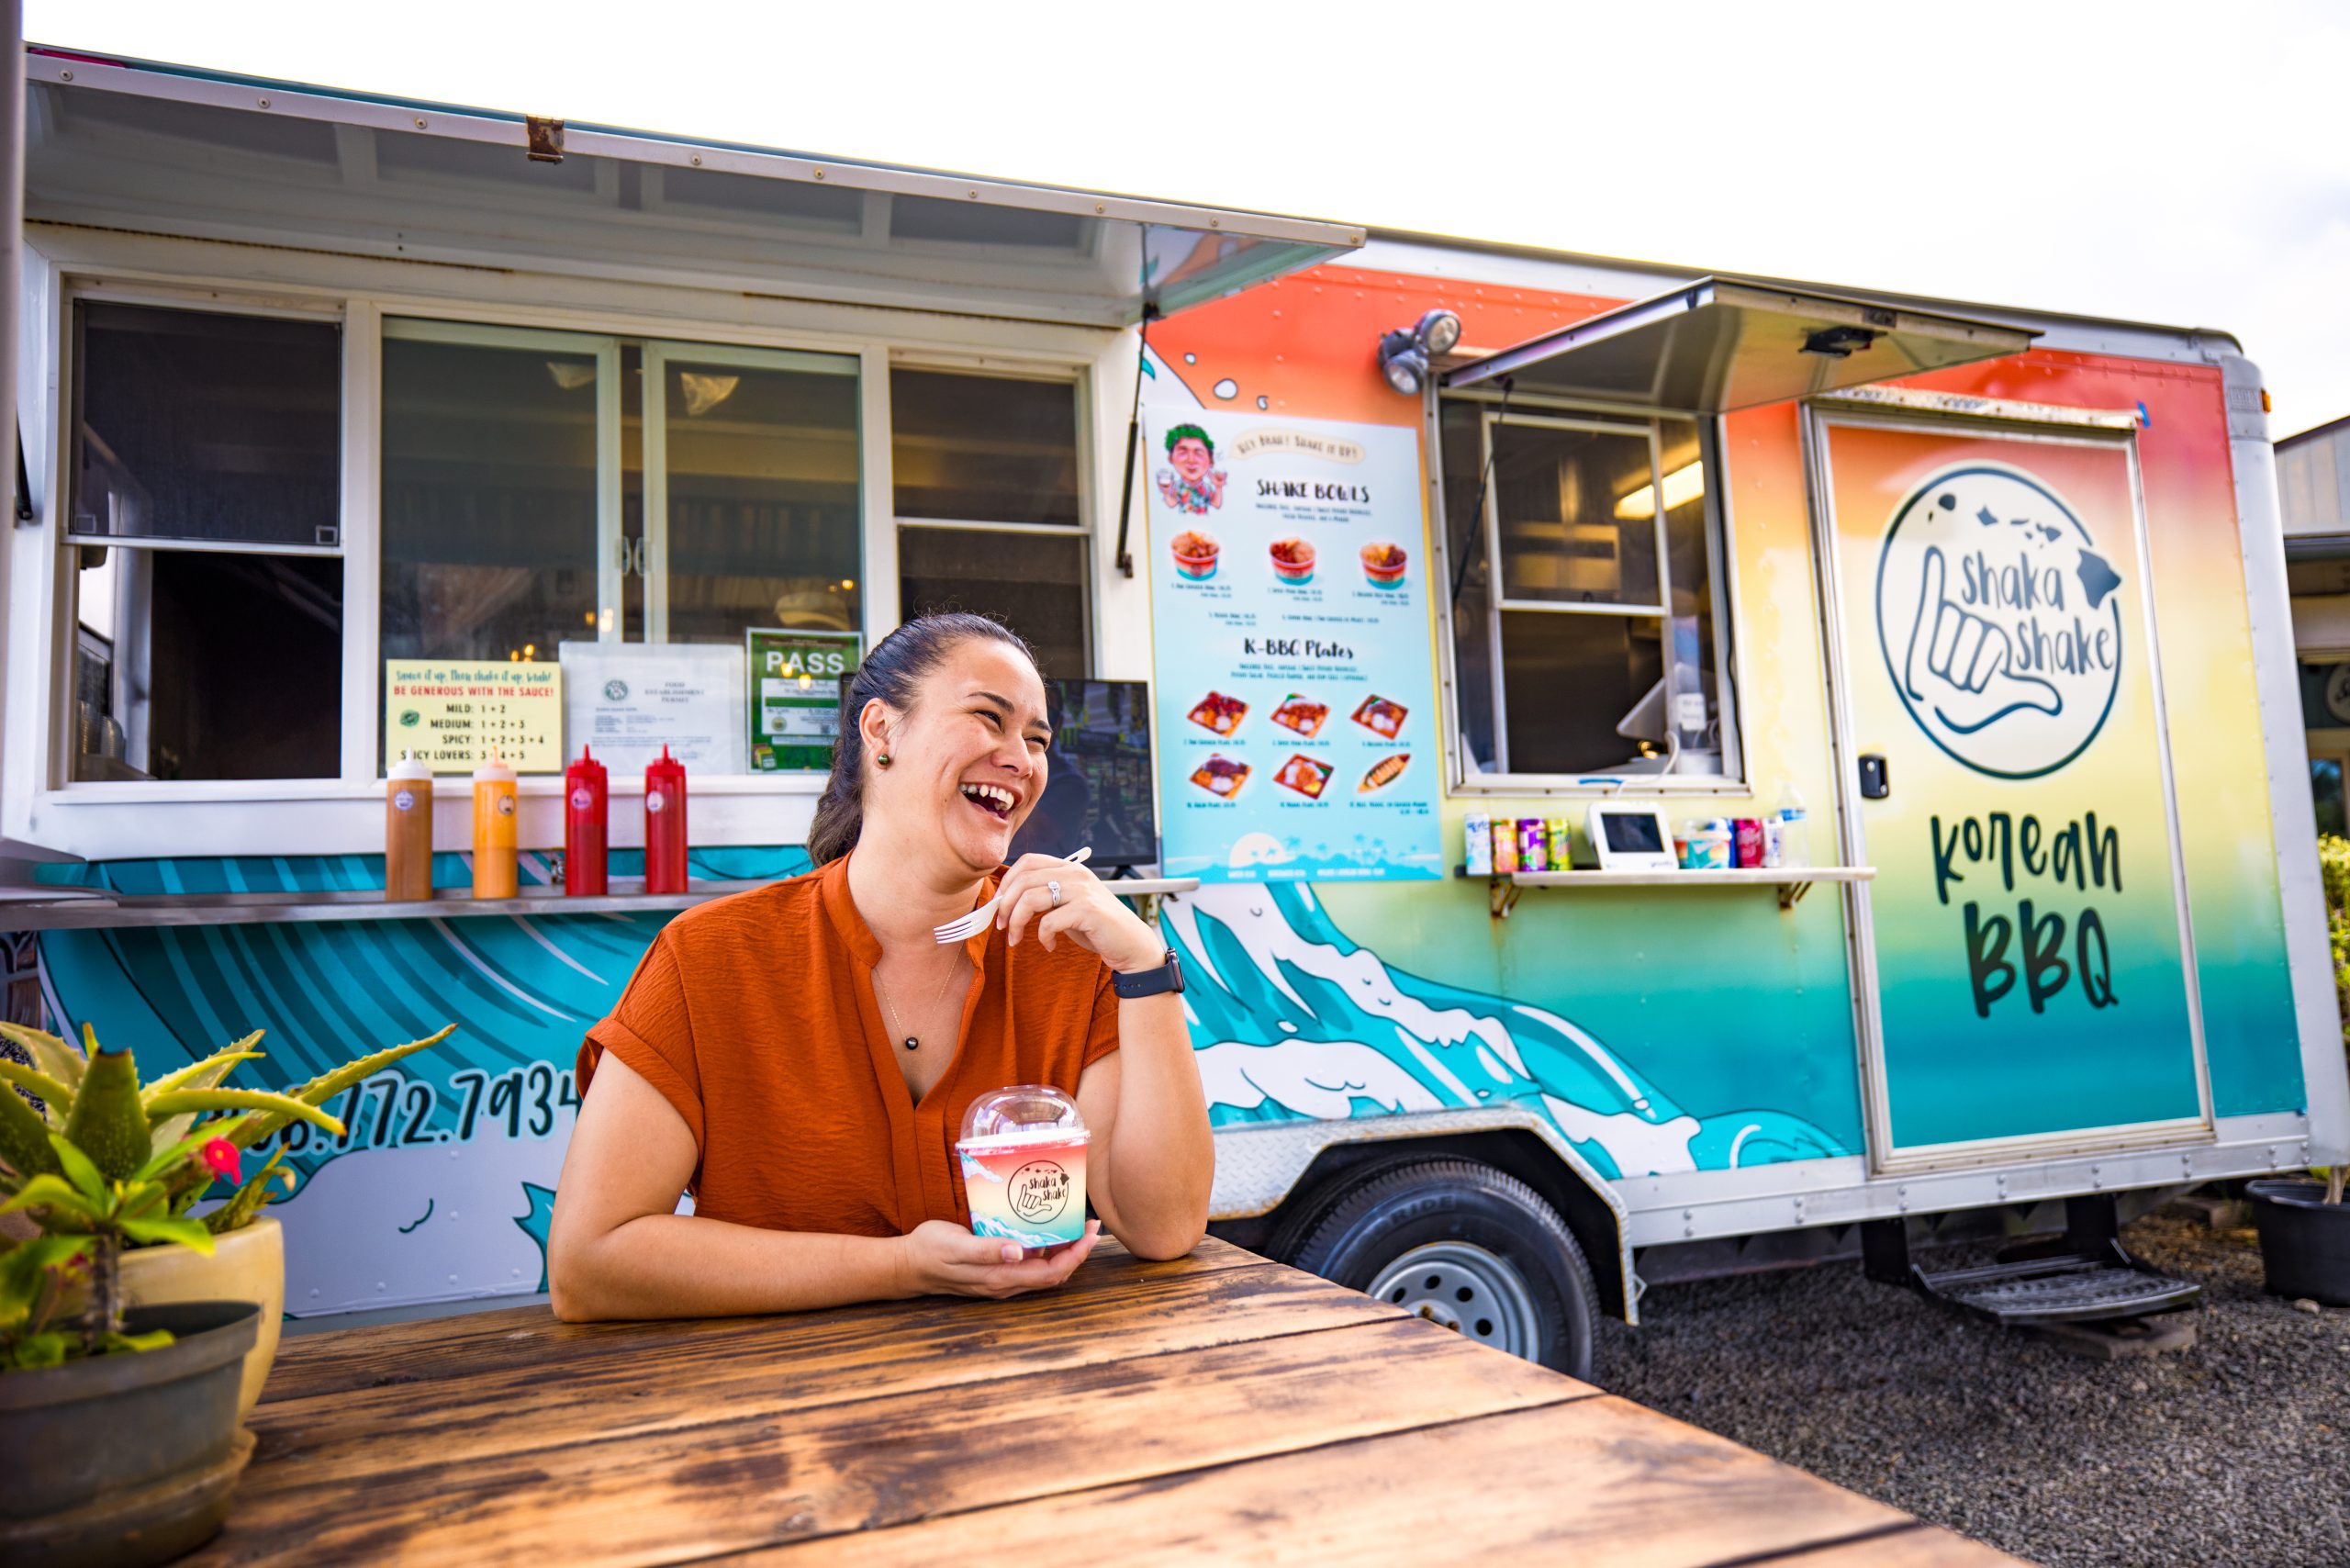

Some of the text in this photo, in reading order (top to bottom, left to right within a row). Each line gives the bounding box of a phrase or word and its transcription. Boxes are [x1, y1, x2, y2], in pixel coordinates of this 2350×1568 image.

[1257, 478, 1370, 503] SHAKE BOWLS
[1962, 550, 2065, 611] shaka
[1305, 639, 1354, 659] Plates
[2017, 615, 2113, 675] shake
[766, 650, 845, 675] PASS
[394, 685, 554, 698] BE GENEROUS WITH THE SAUCE!
[446, 703, 474, 713] MILD:
[500, 703, 506, 713] 2
[430, 720, 474, 729] MEDIUM:
[500, 720, 505, 729] 2
[519, 720, 525, 729] 3
[442, 735, 474, 745] SPICY:
[500, 735, 505, 745] 2
[519, 735, 525, 745] 3
[538, 735, 544, 745] 4
[400, 751, 429, 760] SICY
[434, 751, 474, 760] LOVERS:
[480, 751, 487, 760] 3
[519, 751, 525, 760] 5
[1963, 898, 2119, 1019] BBQ
[1029, 1176, 1057, 1189] shaka
[1043, 1187, 1066, 1201] shake
